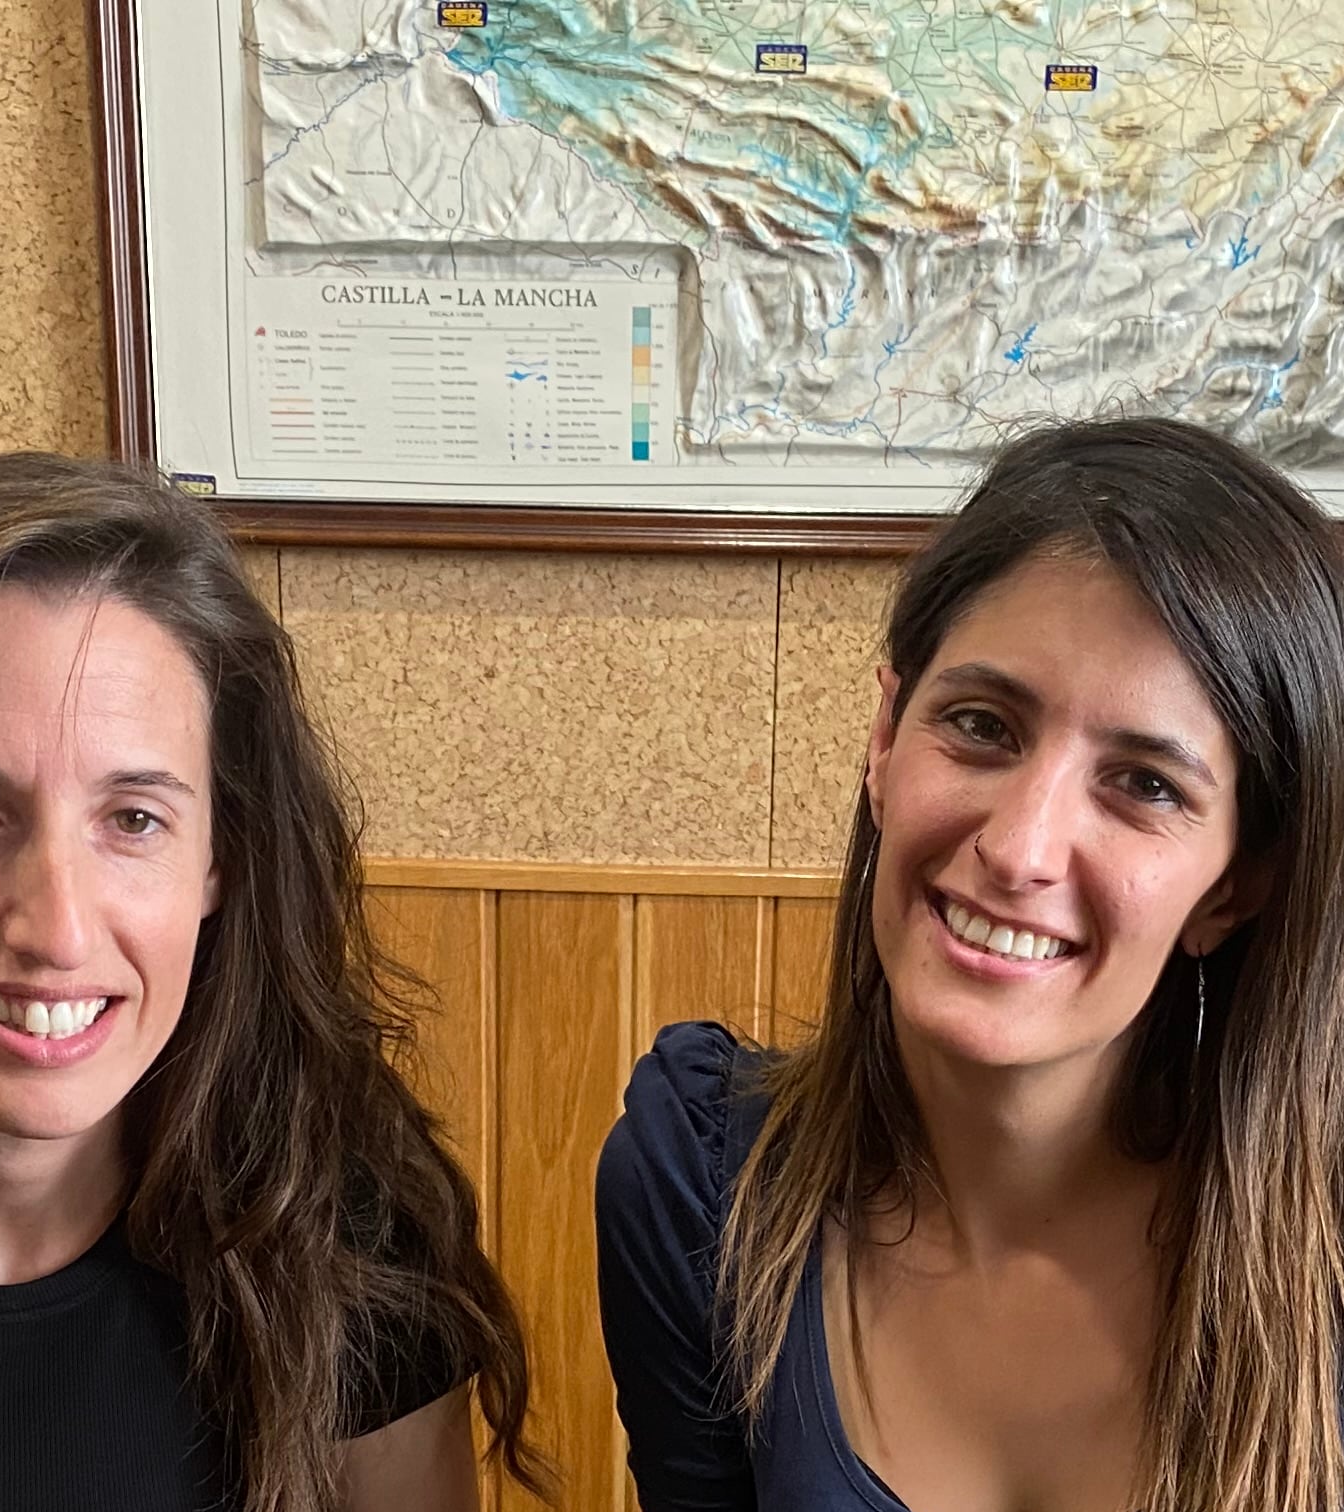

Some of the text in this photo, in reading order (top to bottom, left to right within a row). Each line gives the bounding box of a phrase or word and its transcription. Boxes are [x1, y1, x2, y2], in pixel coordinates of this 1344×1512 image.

[442, 8, 484, 26] SER
[759, 53, 805, 71] SER
[1049, 72, 1093, 90] SER
[321, 285, 430, 305] CASTILLA
[494, 288, 598, 307] MANCHA
[274, 329, 308, 339] TOLEDO
